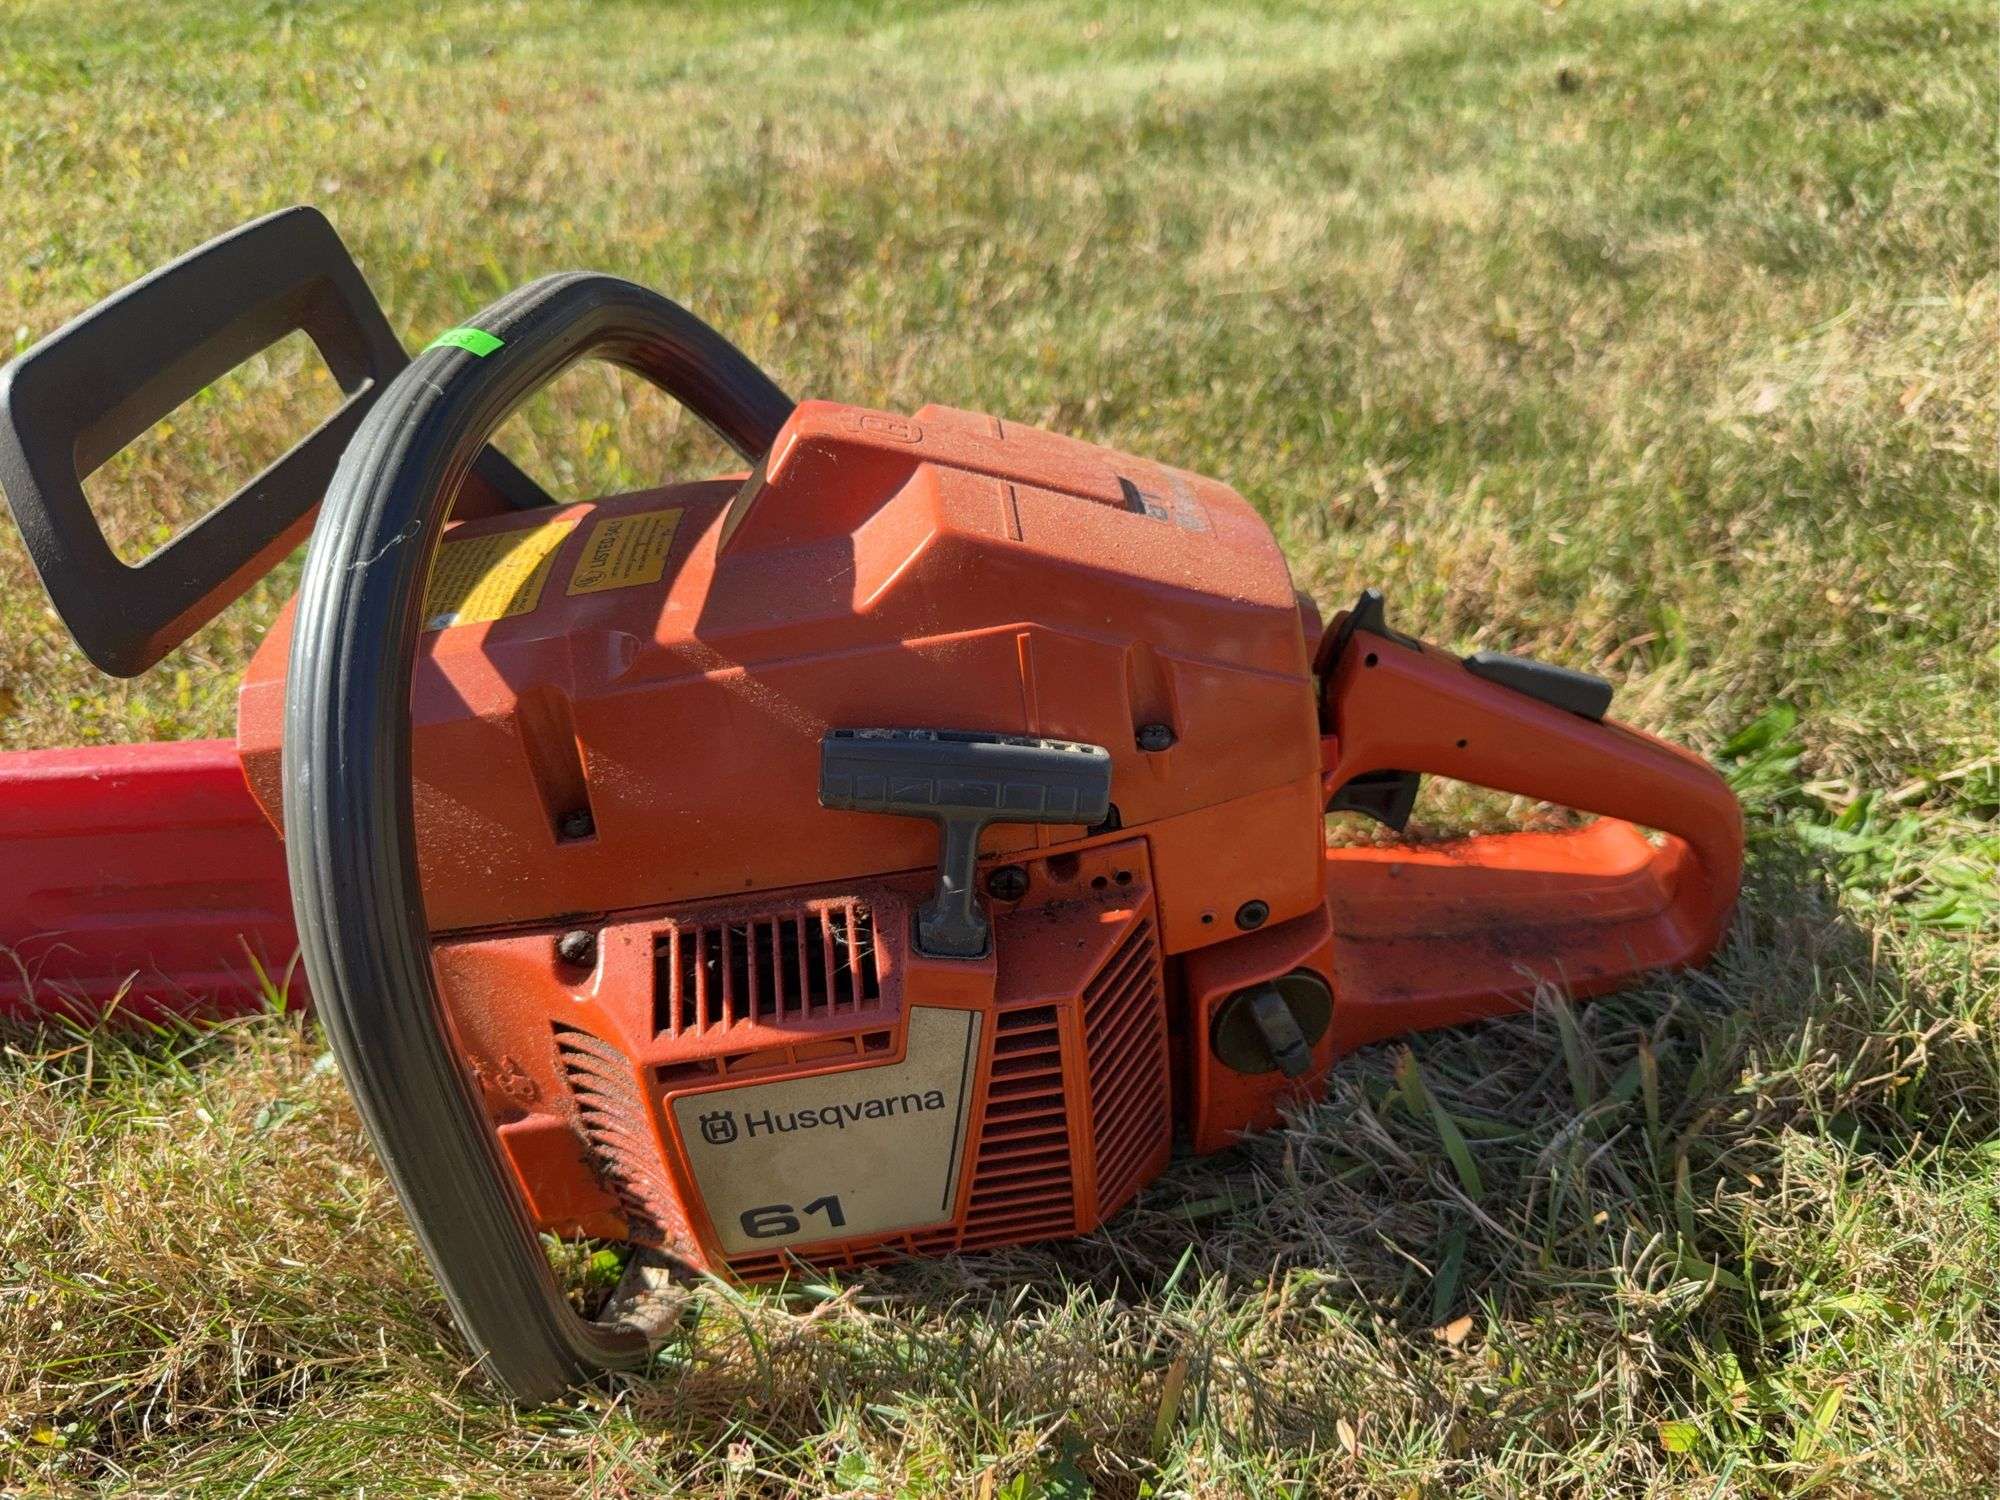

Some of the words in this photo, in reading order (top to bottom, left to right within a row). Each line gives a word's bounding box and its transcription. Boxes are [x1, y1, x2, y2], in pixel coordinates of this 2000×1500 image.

[592, 538, 615, 568] LISTED
[744, 1090, 946, 1137] Husqvarna
[740, 1194, 846, 1238] 61
